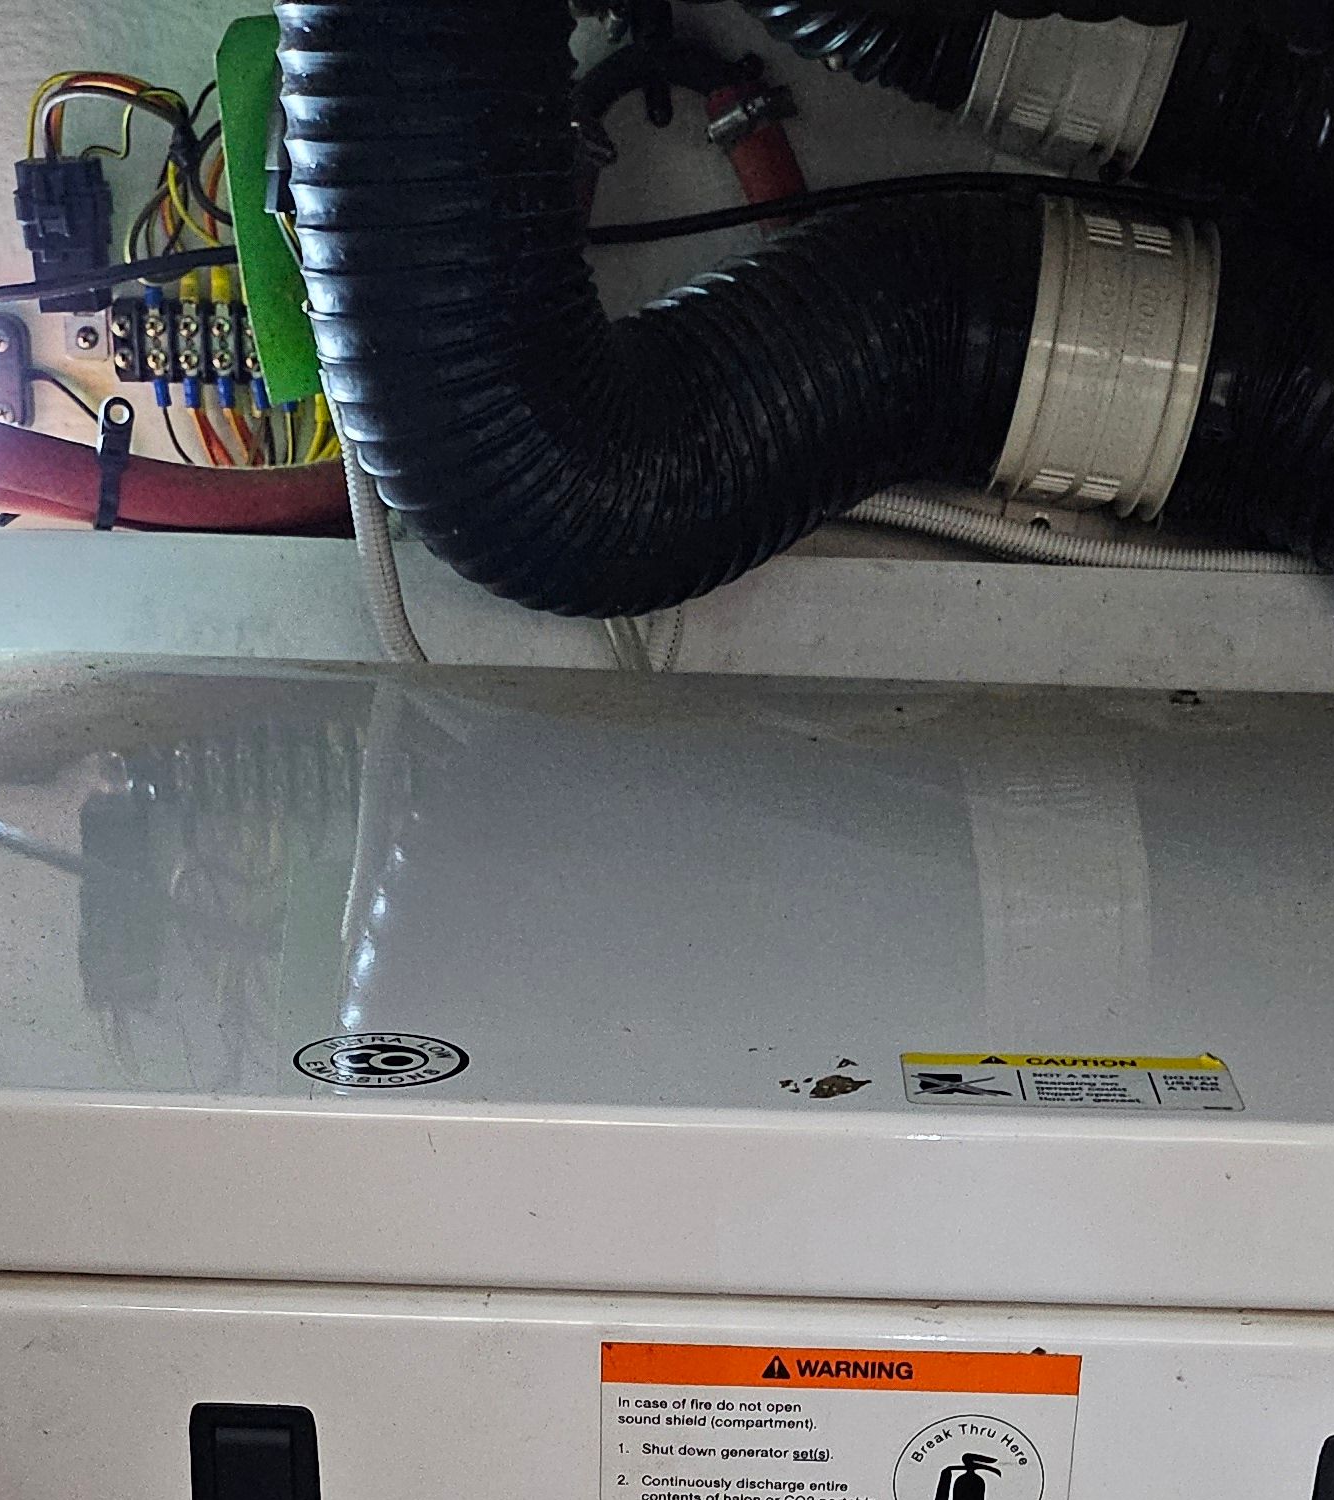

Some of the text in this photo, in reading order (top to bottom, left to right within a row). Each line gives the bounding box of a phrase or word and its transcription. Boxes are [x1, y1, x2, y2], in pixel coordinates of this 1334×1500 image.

[417, 1042, 454, 1059] LOW
[306, 1060, 440, 1084] EMISSIONS
[1025, 1057, 1137, 1067] CAUTION
[796, 1358, 914, 1380] WARNING
[618, 1395, 802, 1415] In case of fire do not open
[617, 1412, 817, 1432] sound shield (compartment).
[618, 1441, 834, 1463] 1. Shut down generator set(s).
[911, 1422, 1028, 1467] Break Thru Here
[616, 1473, 848, 1494] 2. Continuously discharge entire
